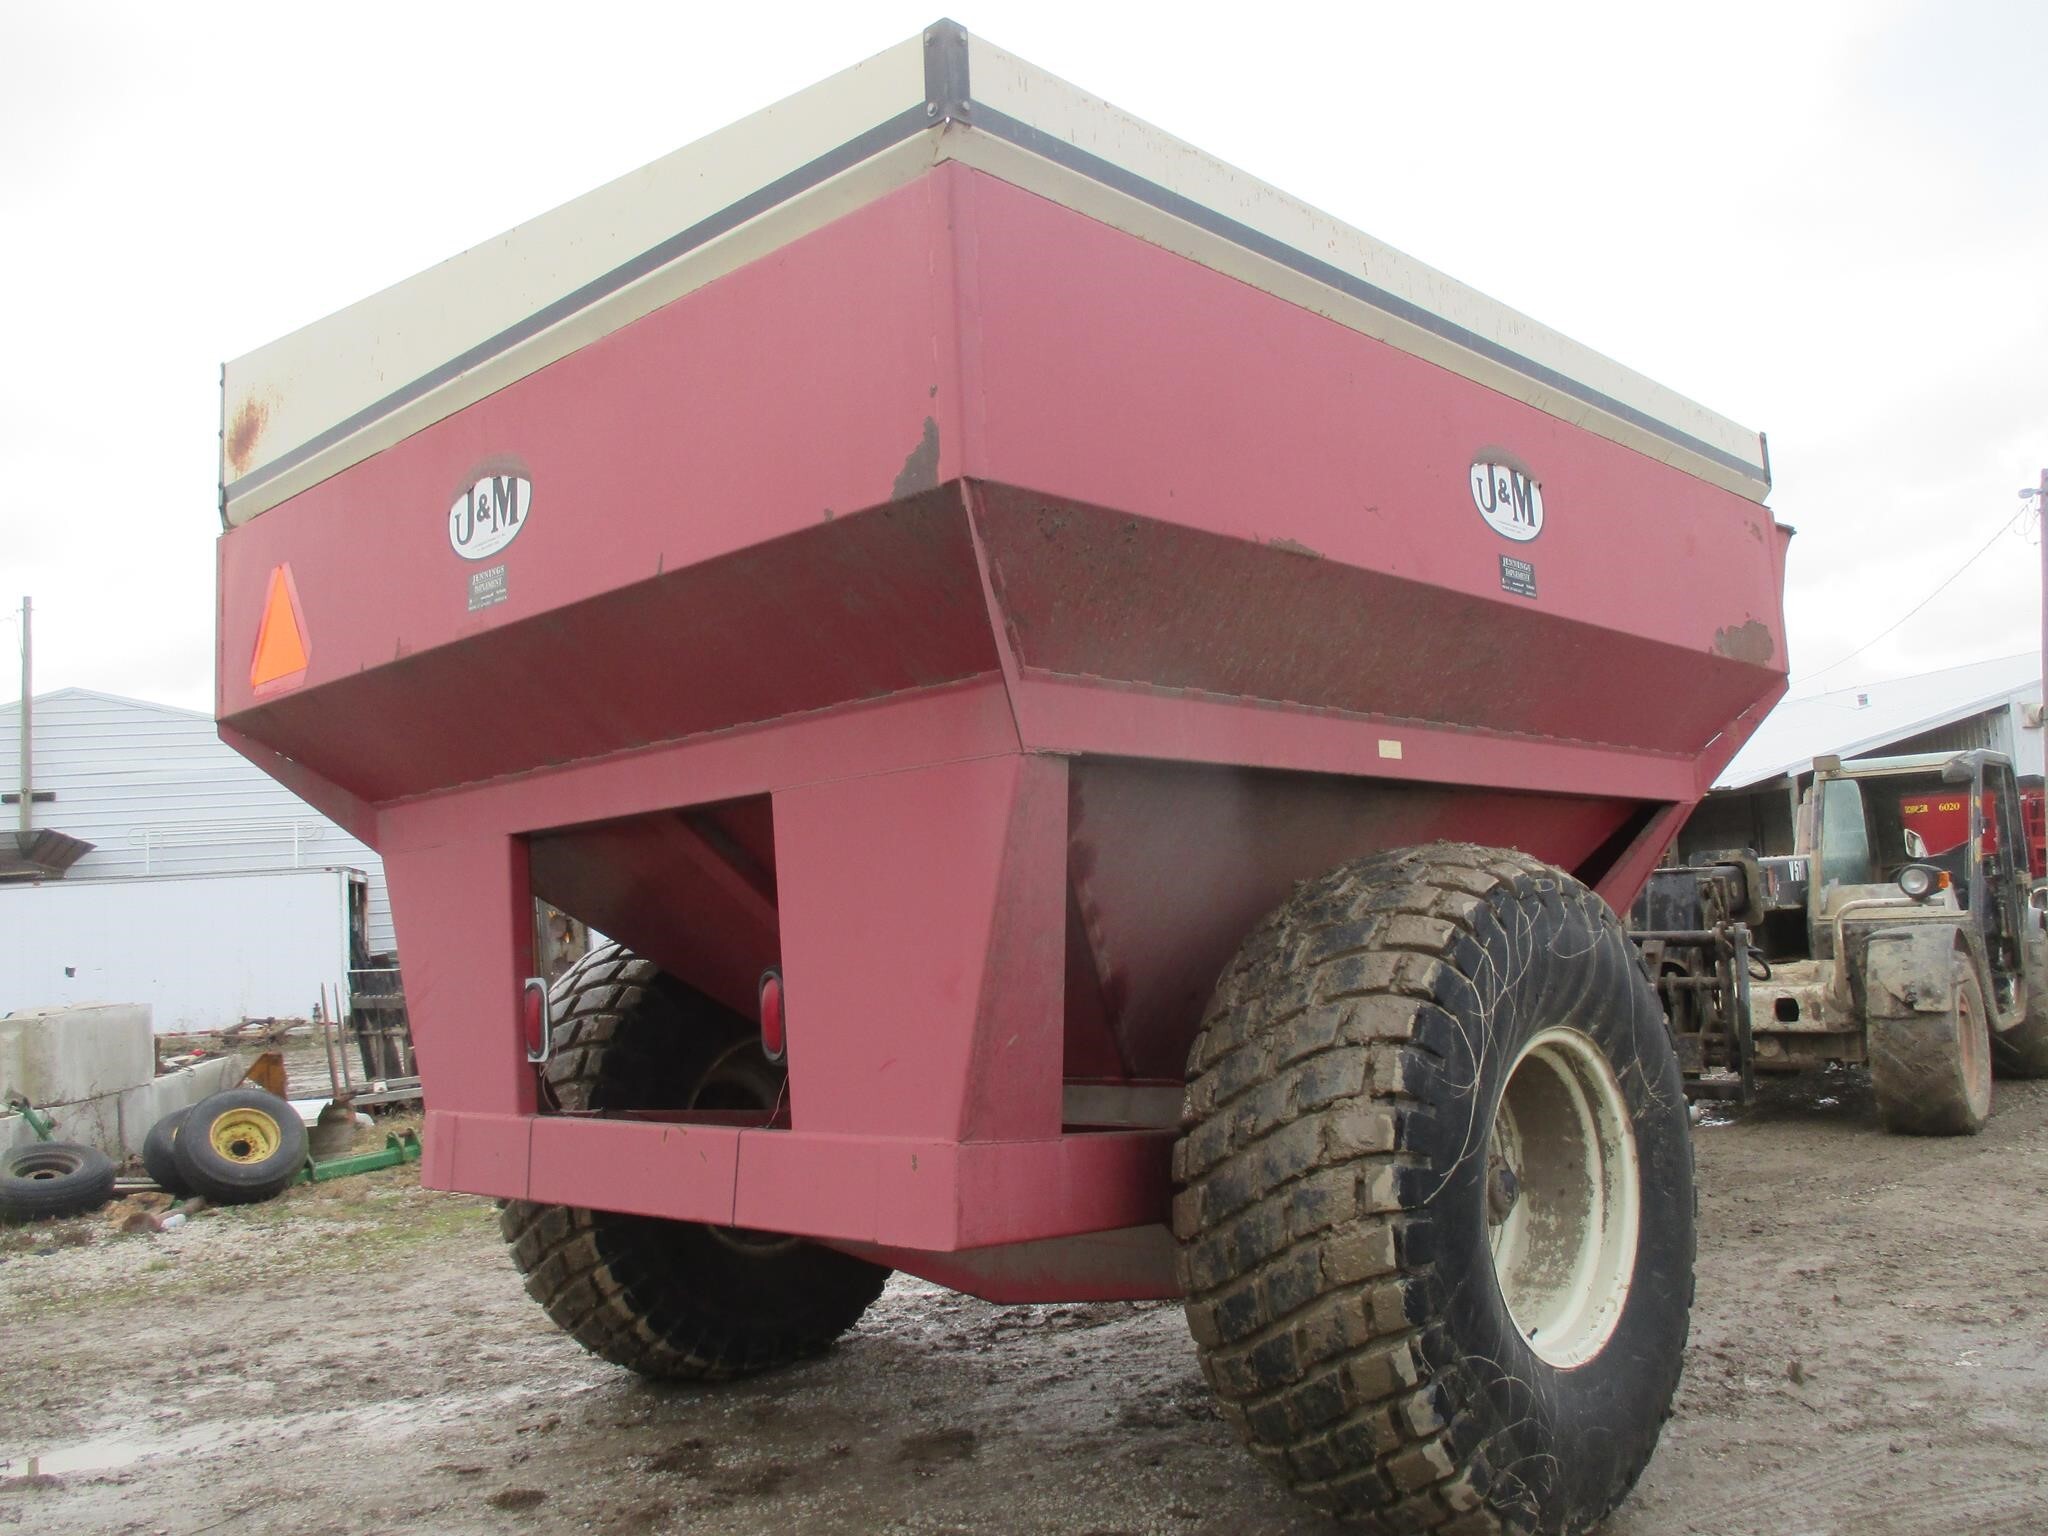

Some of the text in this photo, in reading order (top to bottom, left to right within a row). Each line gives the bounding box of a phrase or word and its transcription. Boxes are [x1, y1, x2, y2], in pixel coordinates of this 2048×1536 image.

[454, 476, 520, 546] J&M
[1476, 463, 1536, 528] J&M
[1938, 802, 1960, 812] 6020
